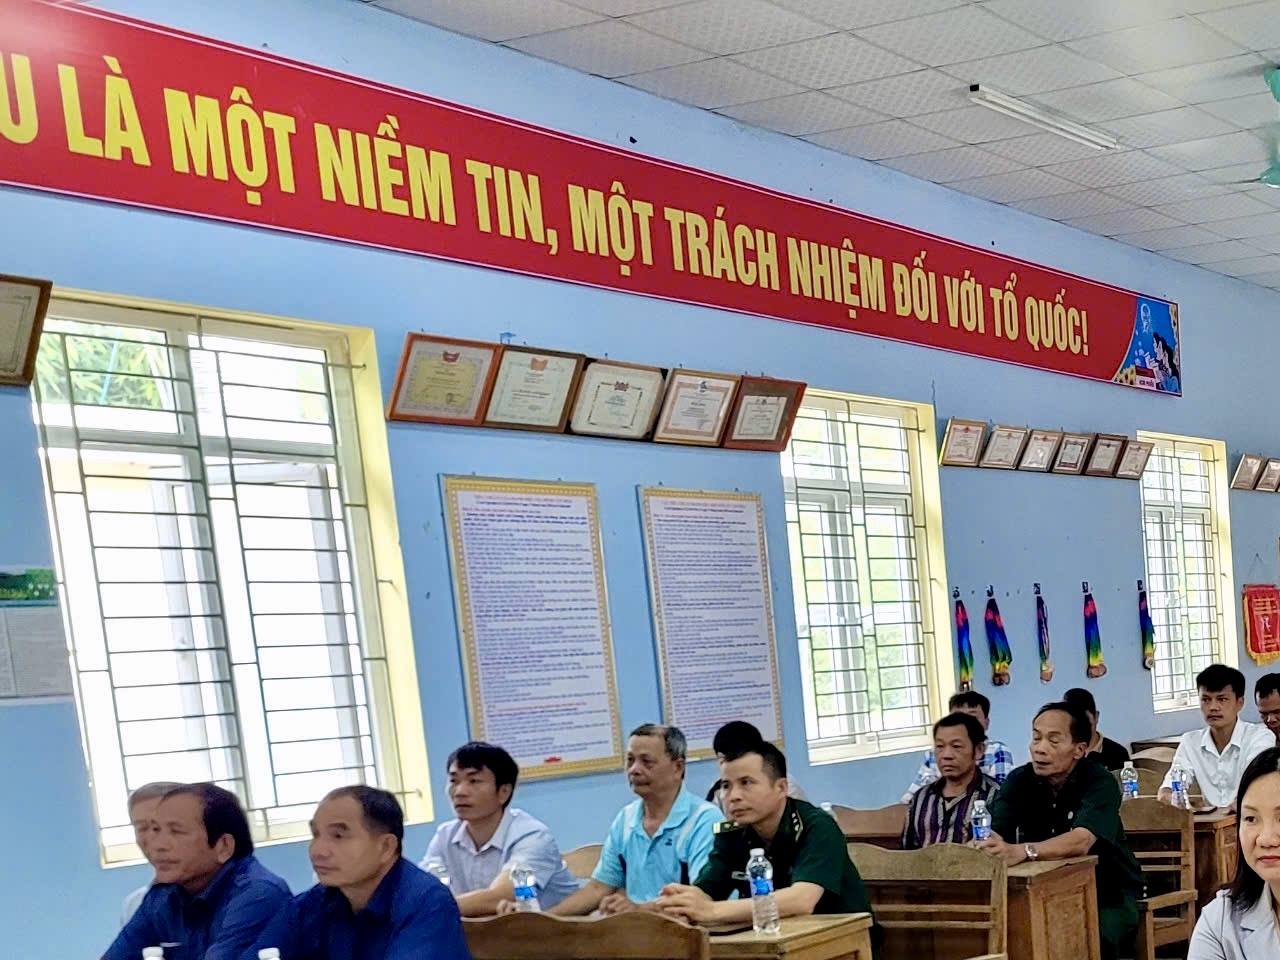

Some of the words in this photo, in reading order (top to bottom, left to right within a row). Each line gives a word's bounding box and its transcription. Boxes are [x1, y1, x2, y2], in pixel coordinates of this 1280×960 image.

[57, 55, 152, 168] LÀ
[163, 86, 297, 207] MỘT
[314, 115, 457, 226] NIỀM
[465, 158, 559, 256] TIN,
[568, 180, 654, 277] MỘT
[664, 205, 780, 292] TRÁCH
[786, 237, 887, 321] NHIỆM
[891, 249, 938, 323] ĐỐI
[943, 269, 986, 334] VỚI
[989, 271, 1020, 341] TỔ
[1025, 288, 1089, 356] QUỐC!
